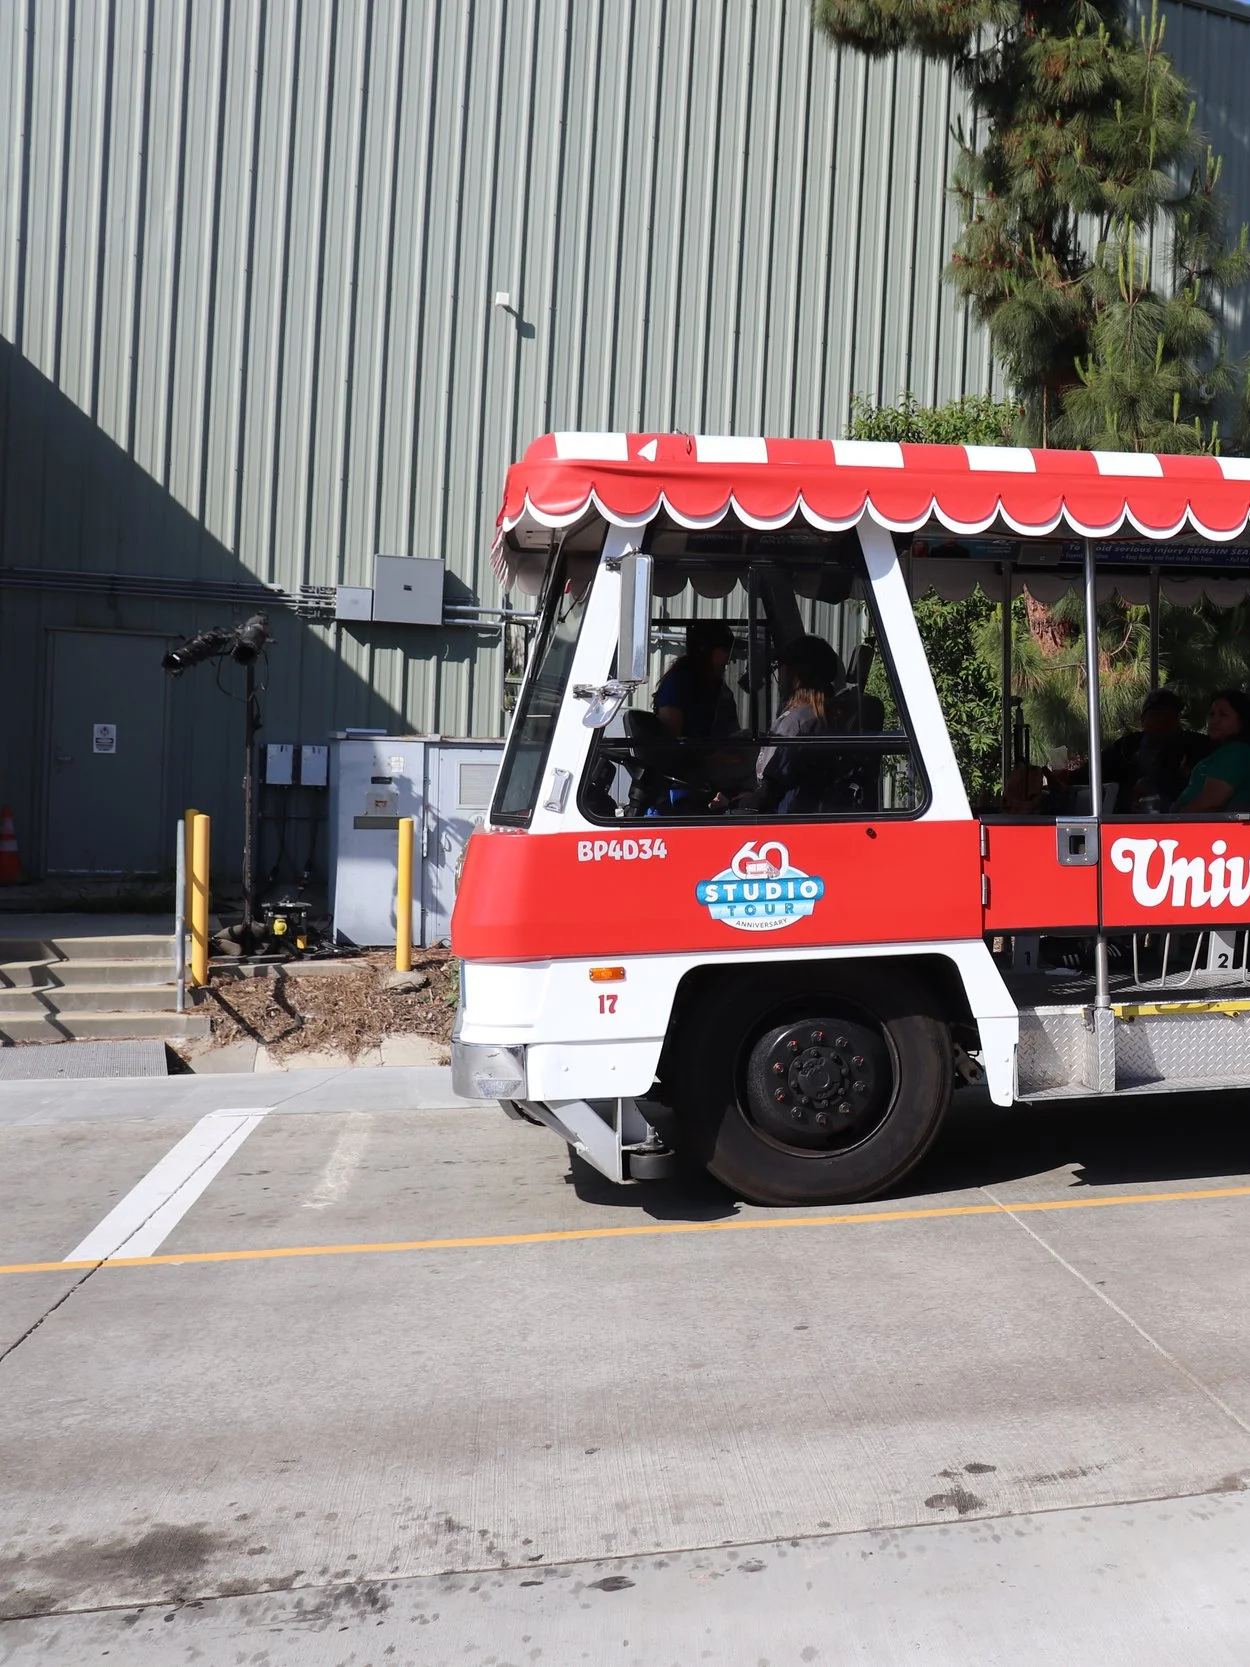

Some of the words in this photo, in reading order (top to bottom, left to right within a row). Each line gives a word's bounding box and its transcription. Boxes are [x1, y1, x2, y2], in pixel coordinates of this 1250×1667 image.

[1187, 547, 1228, 555] REMAIN
[577, 838, 668, 862] BP4D34
[731, 841, 789, 880] 60
[704, 880, 819, 902] STUDIO
[717, 902, 795, 917] TOUR
[735, 917, 788, 929] ANNIVERSARY
[1217, 952, 1229, 969] 2
[598, 994, 619, 1015] 17
